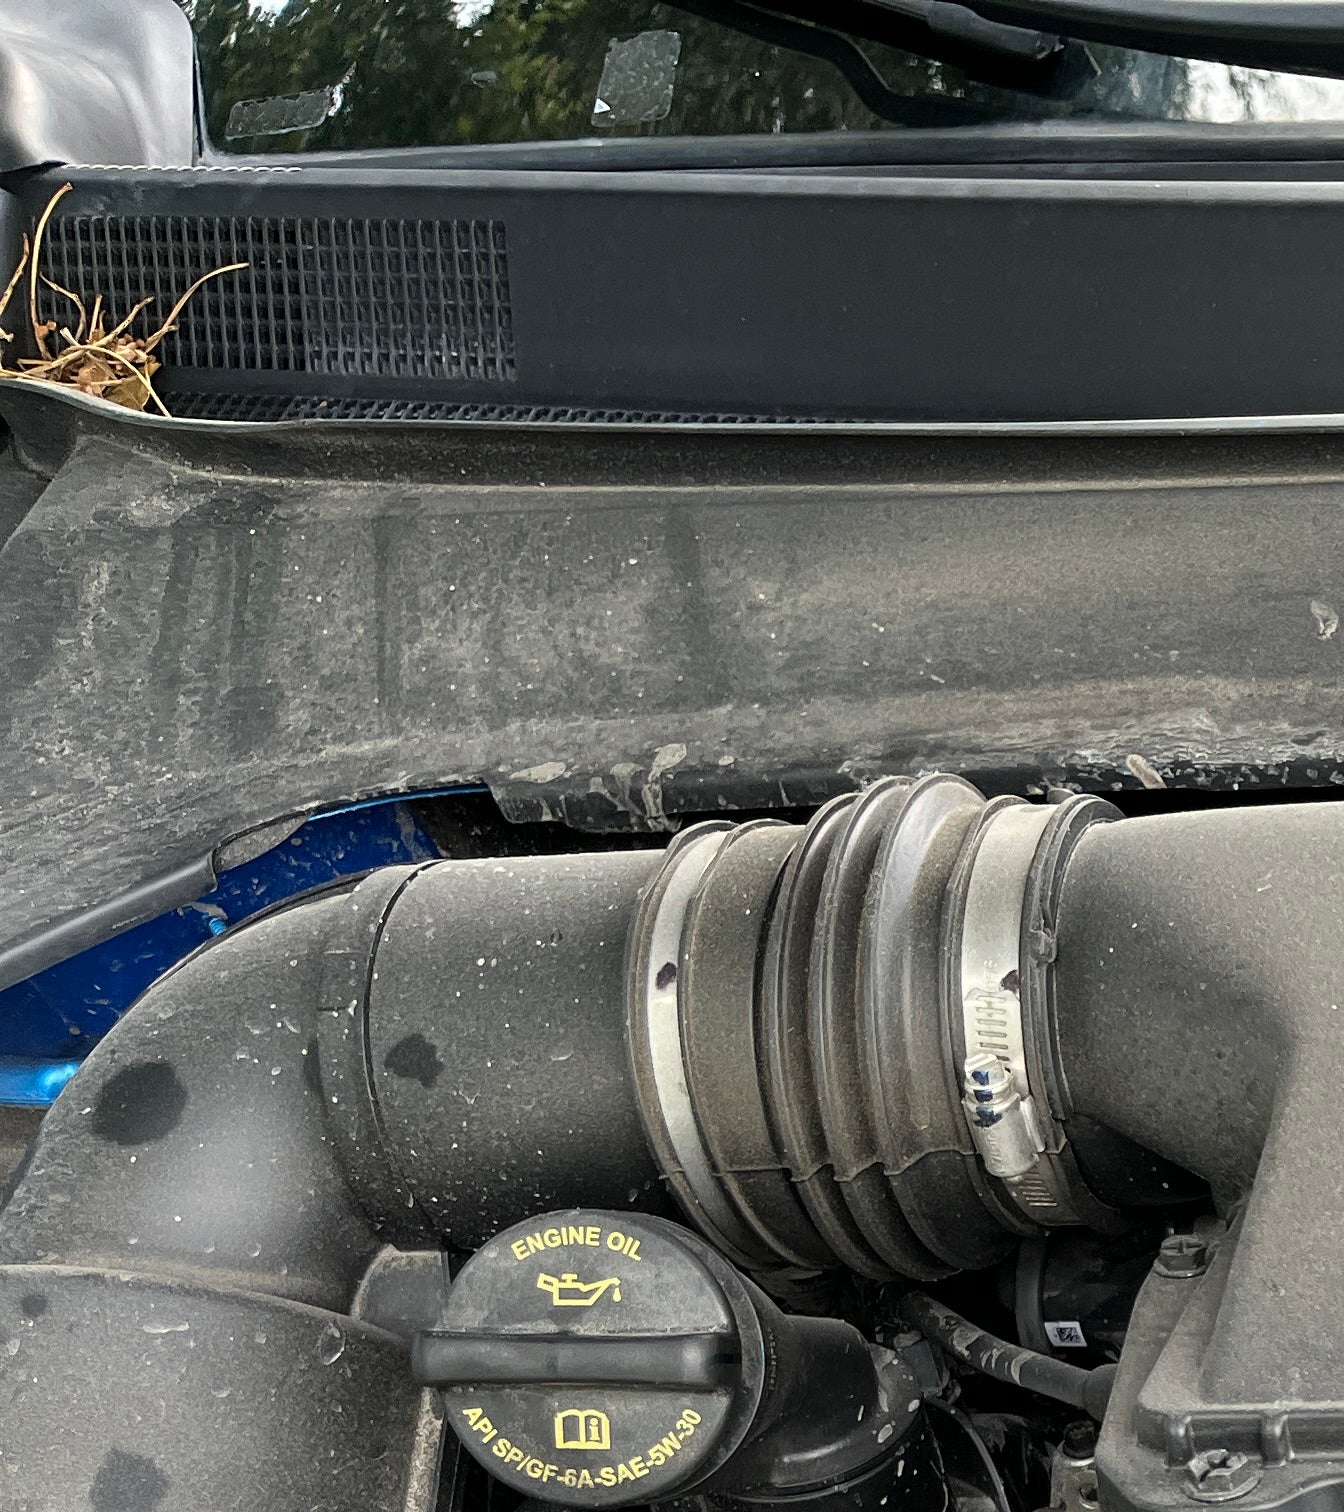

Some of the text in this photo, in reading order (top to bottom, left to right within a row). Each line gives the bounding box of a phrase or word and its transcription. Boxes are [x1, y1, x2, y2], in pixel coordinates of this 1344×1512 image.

[511, 1226, 642, 1261] ENGINE OIL
[462, 1406, 702, 1488] API SP/GF-6A-SAE-5W-30
